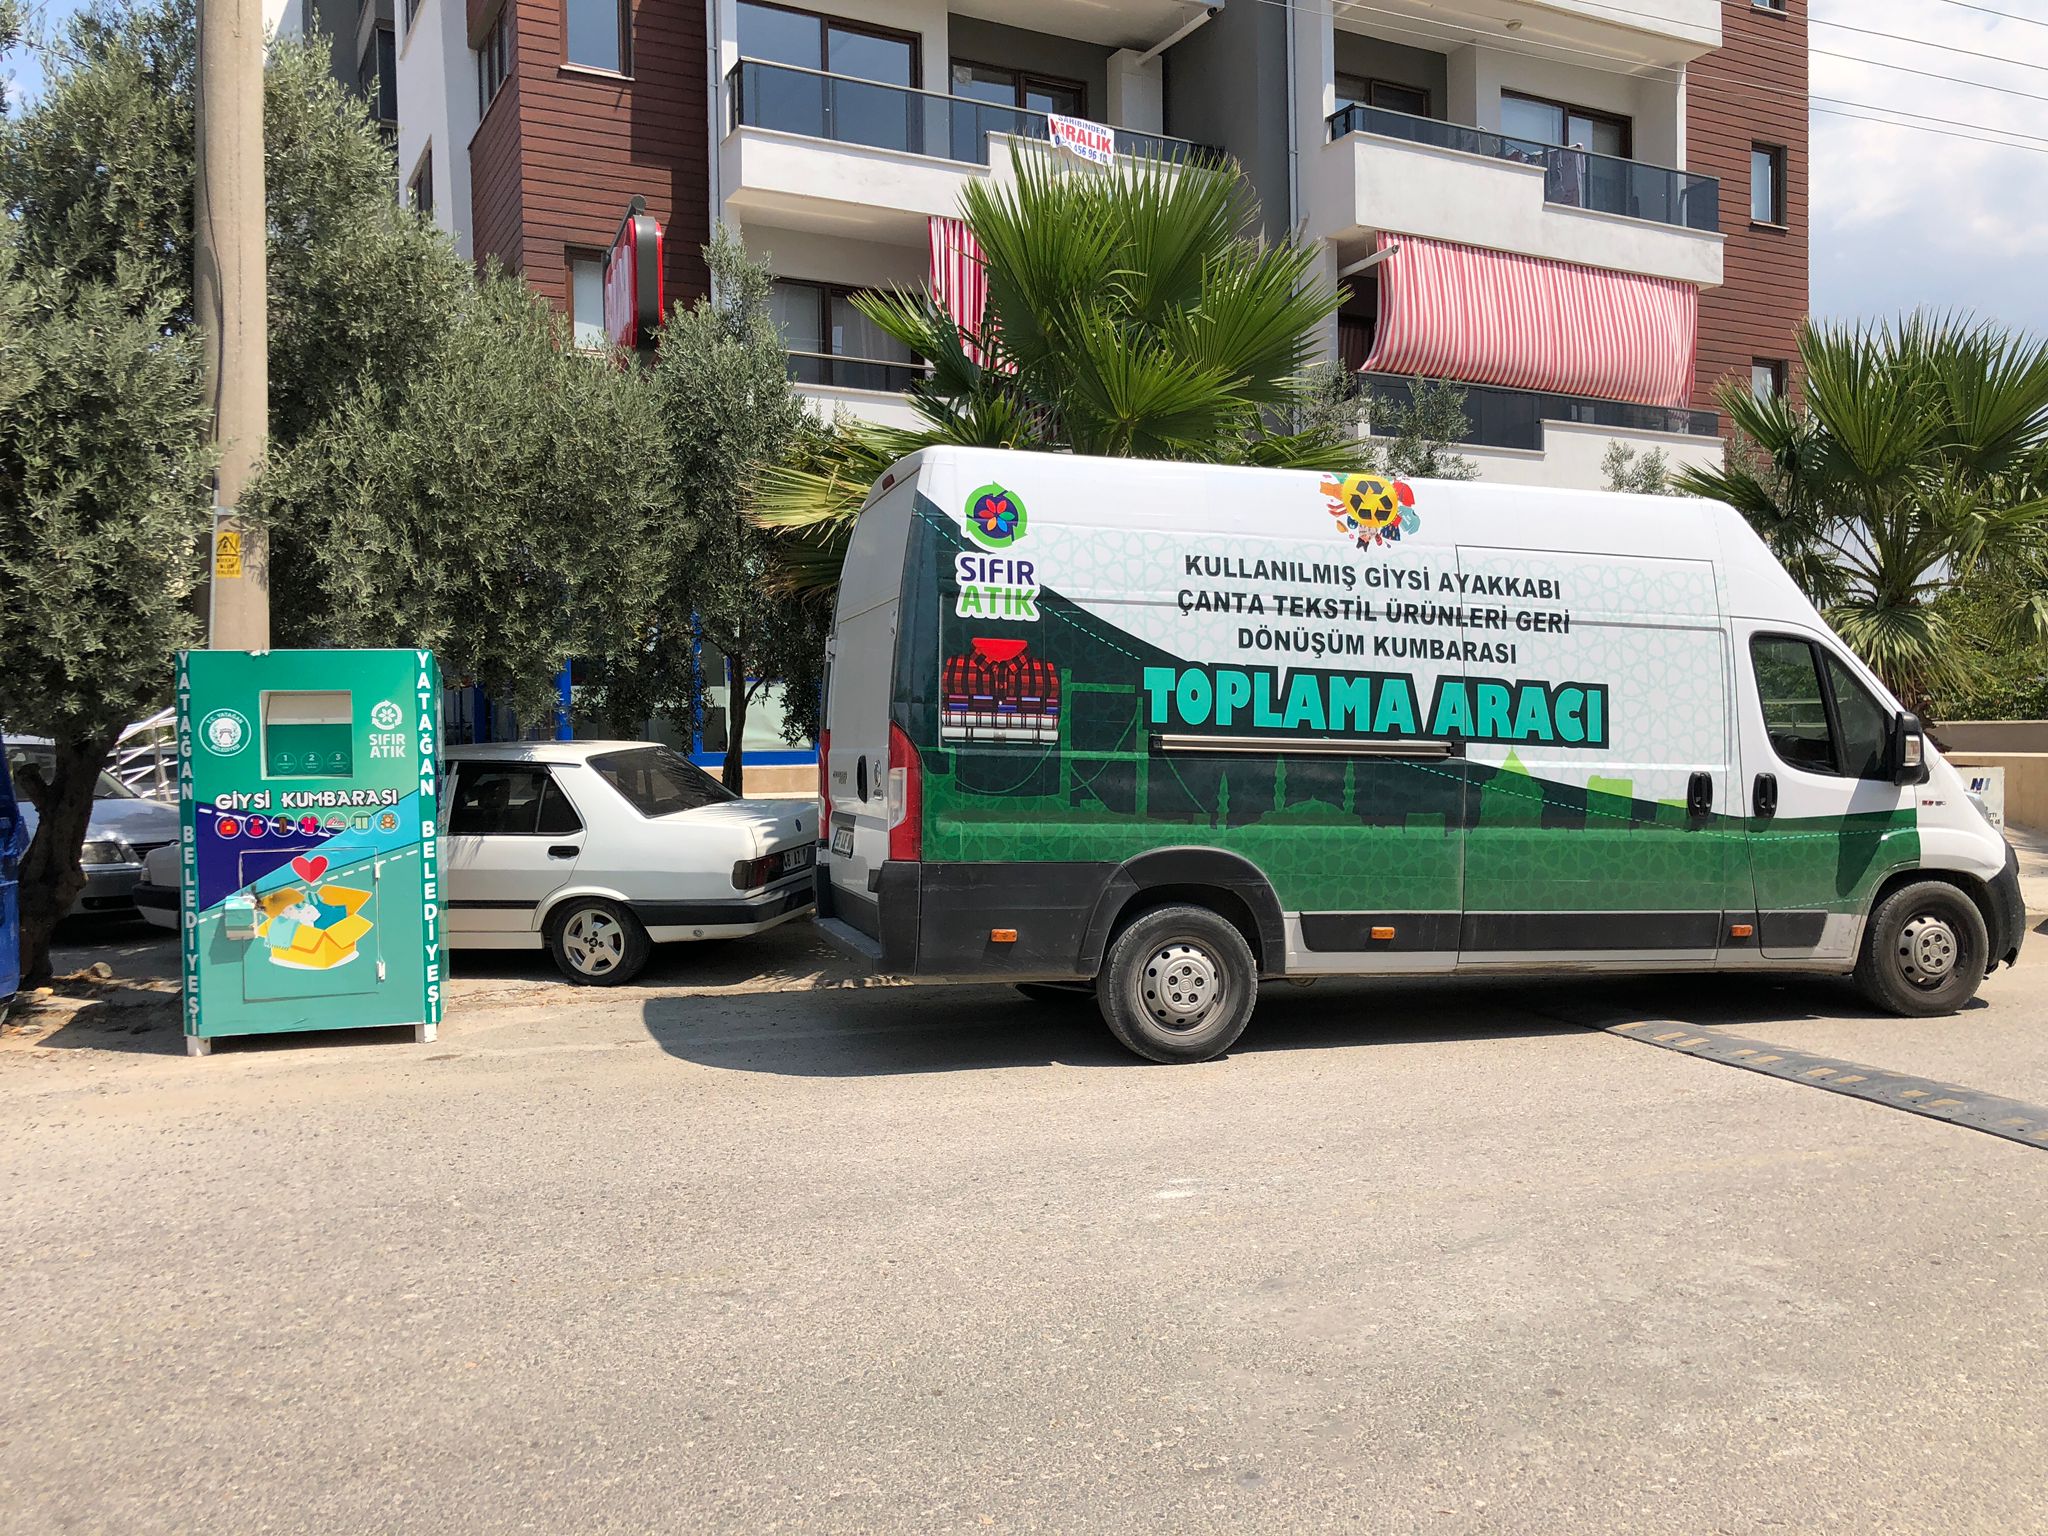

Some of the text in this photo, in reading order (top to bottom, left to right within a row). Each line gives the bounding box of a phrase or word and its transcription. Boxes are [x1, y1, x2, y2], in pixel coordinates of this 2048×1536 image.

[1088, 149, 1097, 160] 96
[960, 556, 1035, 585] SIFIR
[1185, 555, 1561, 600] KULLANILMIŞ GİYSİ AYAKKABI
[961, 585, 1035, 617] ATIK
[1177, 589, 1570, 634] ÇANTA TEKSTİL ÜRÜNLERİ GERİ
[1238, 624, 1517, 665] DÖNÜŞÜM KUMBARASI
[1143, 665, 1603, 743] TOPLAMA ARACI
[368, 733, 406, 746] SIFIR
[369, 745, 406, 758] ATIK
[283, 754, 288, 762] 1
[335, 753, 341, 761] 3
[215, 789, 399, 810] GİYSİ KUMBARASI
[178, 651, 199, 1036] YATAĞAN BELEDİYESİ
[416, 651, 440, 1023] YATAĞAN BELEDİYESİ
